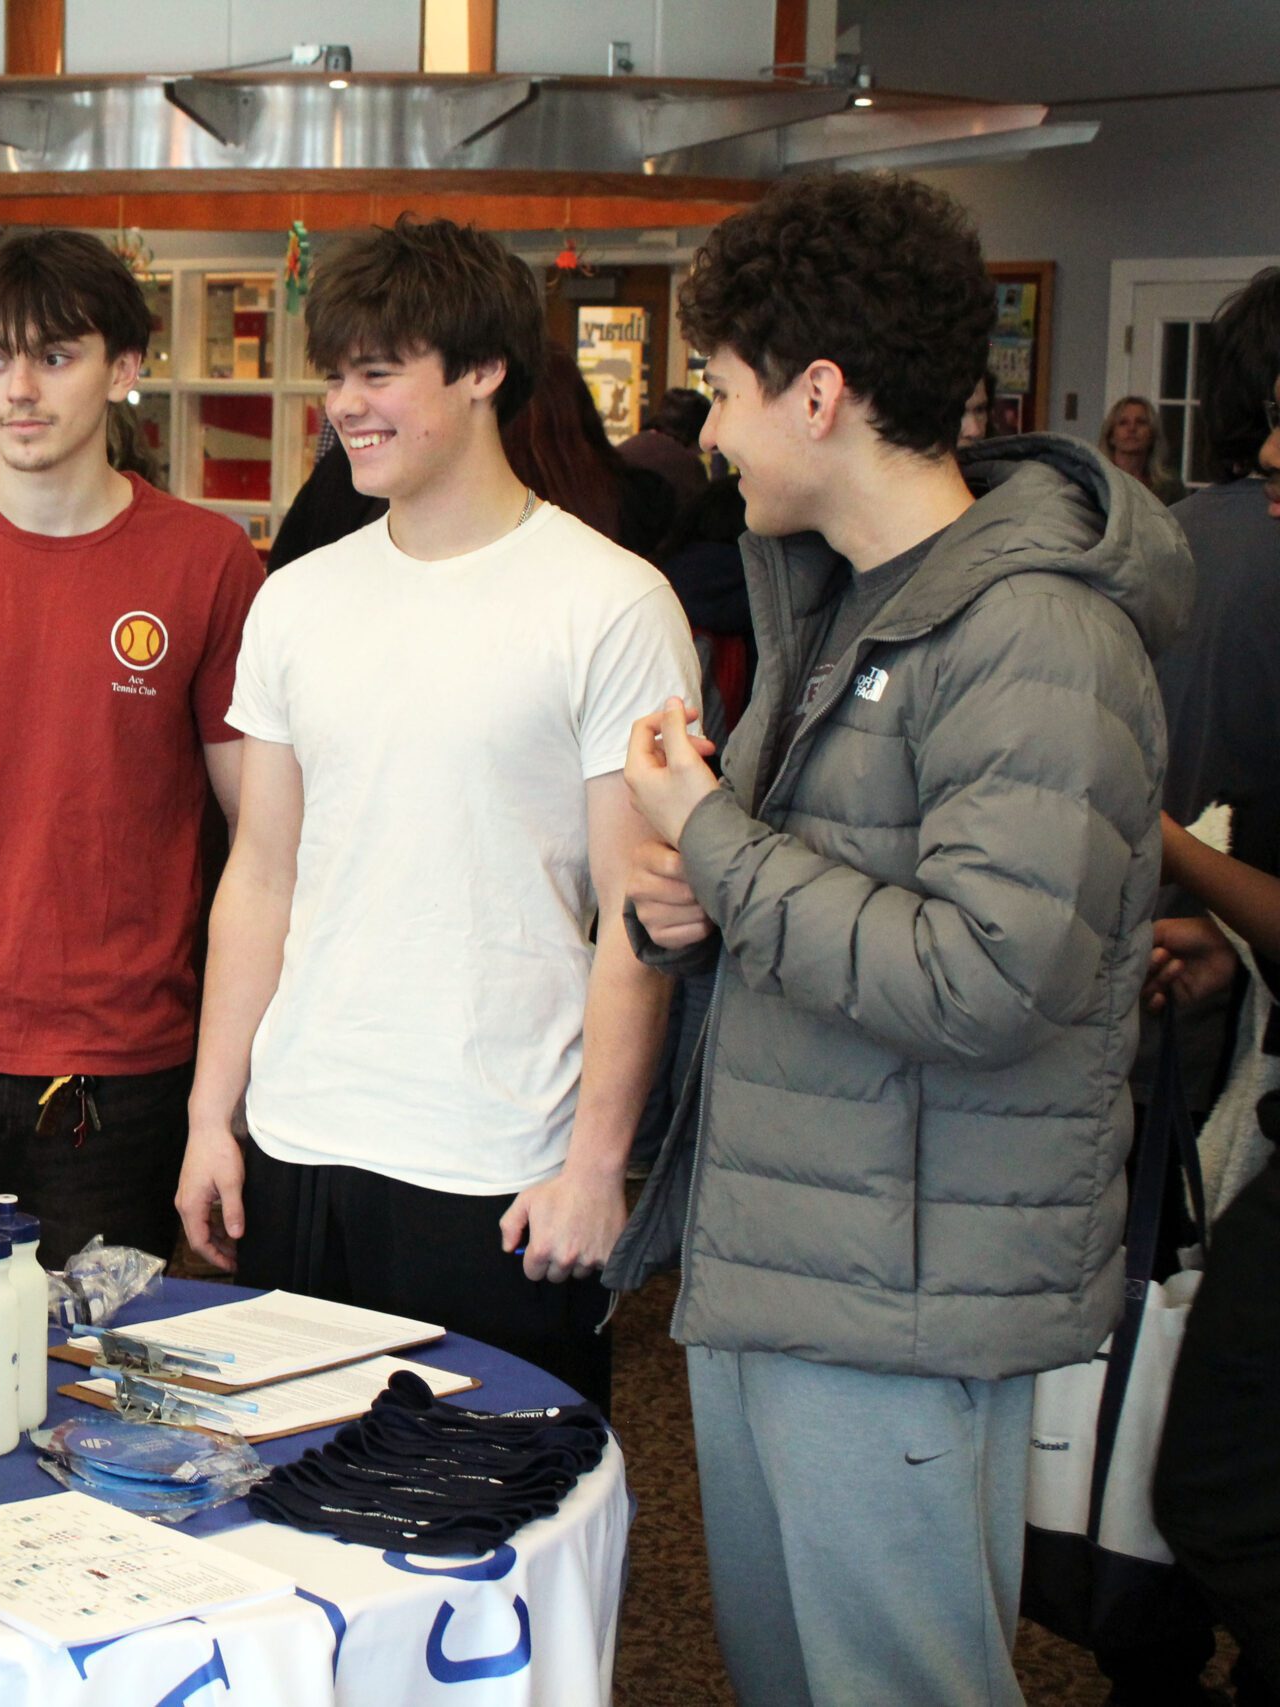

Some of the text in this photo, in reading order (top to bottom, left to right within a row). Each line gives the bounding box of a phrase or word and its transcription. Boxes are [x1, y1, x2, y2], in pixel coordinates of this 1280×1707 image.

[128, 674, 144, 685] Ace
[111, 682, 157, 696] Tennis Club
